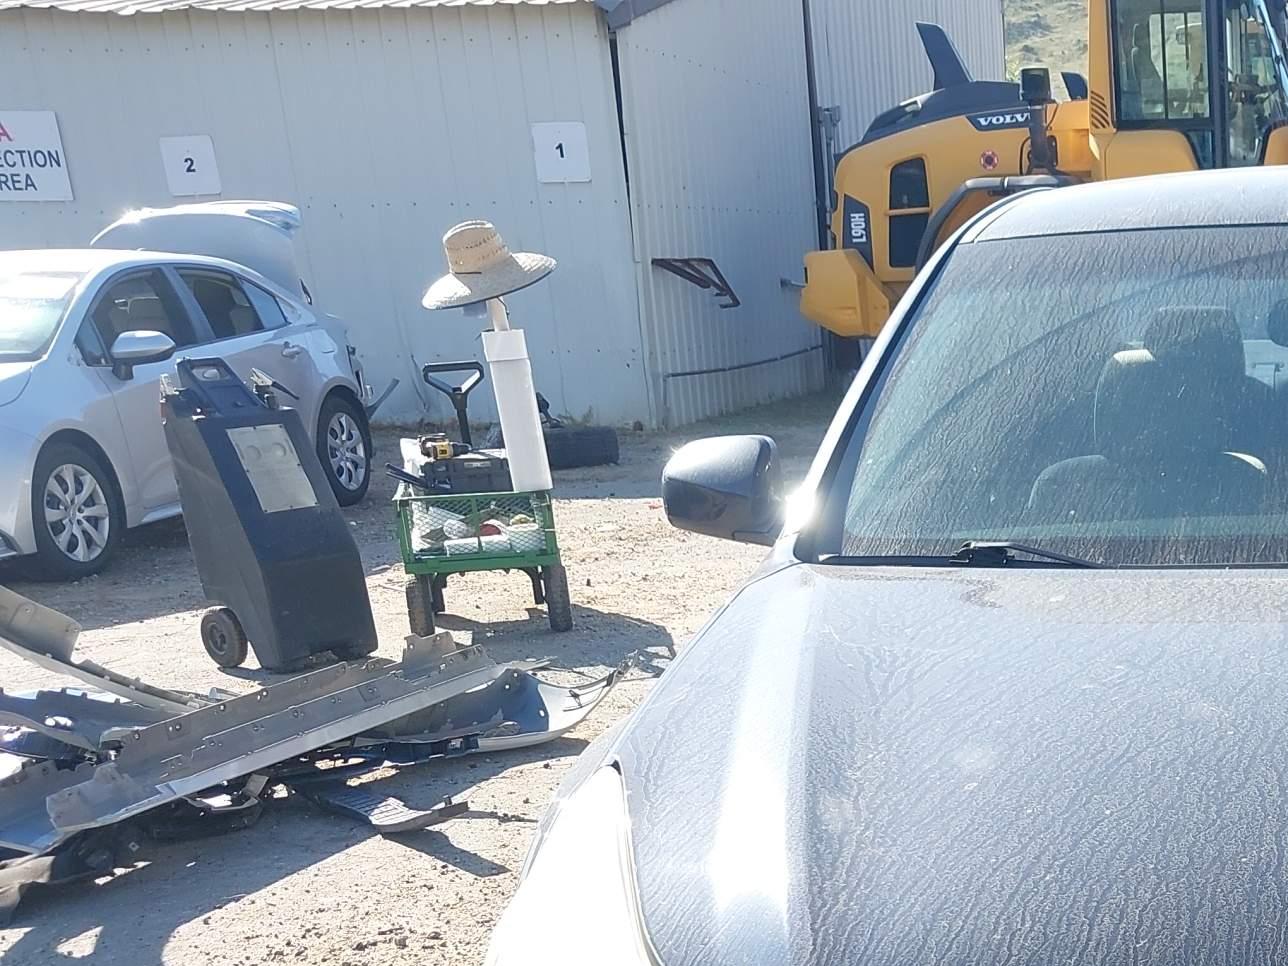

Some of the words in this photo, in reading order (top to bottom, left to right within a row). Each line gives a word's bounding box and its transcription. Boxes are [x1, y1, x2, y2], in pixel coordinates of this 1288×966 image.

[977, 112, 1030, 126] VOLV
[555, 143, 564, 158] 1
[184, 157, 196, 172] 2
[850, 213, 867, 243] L90H
